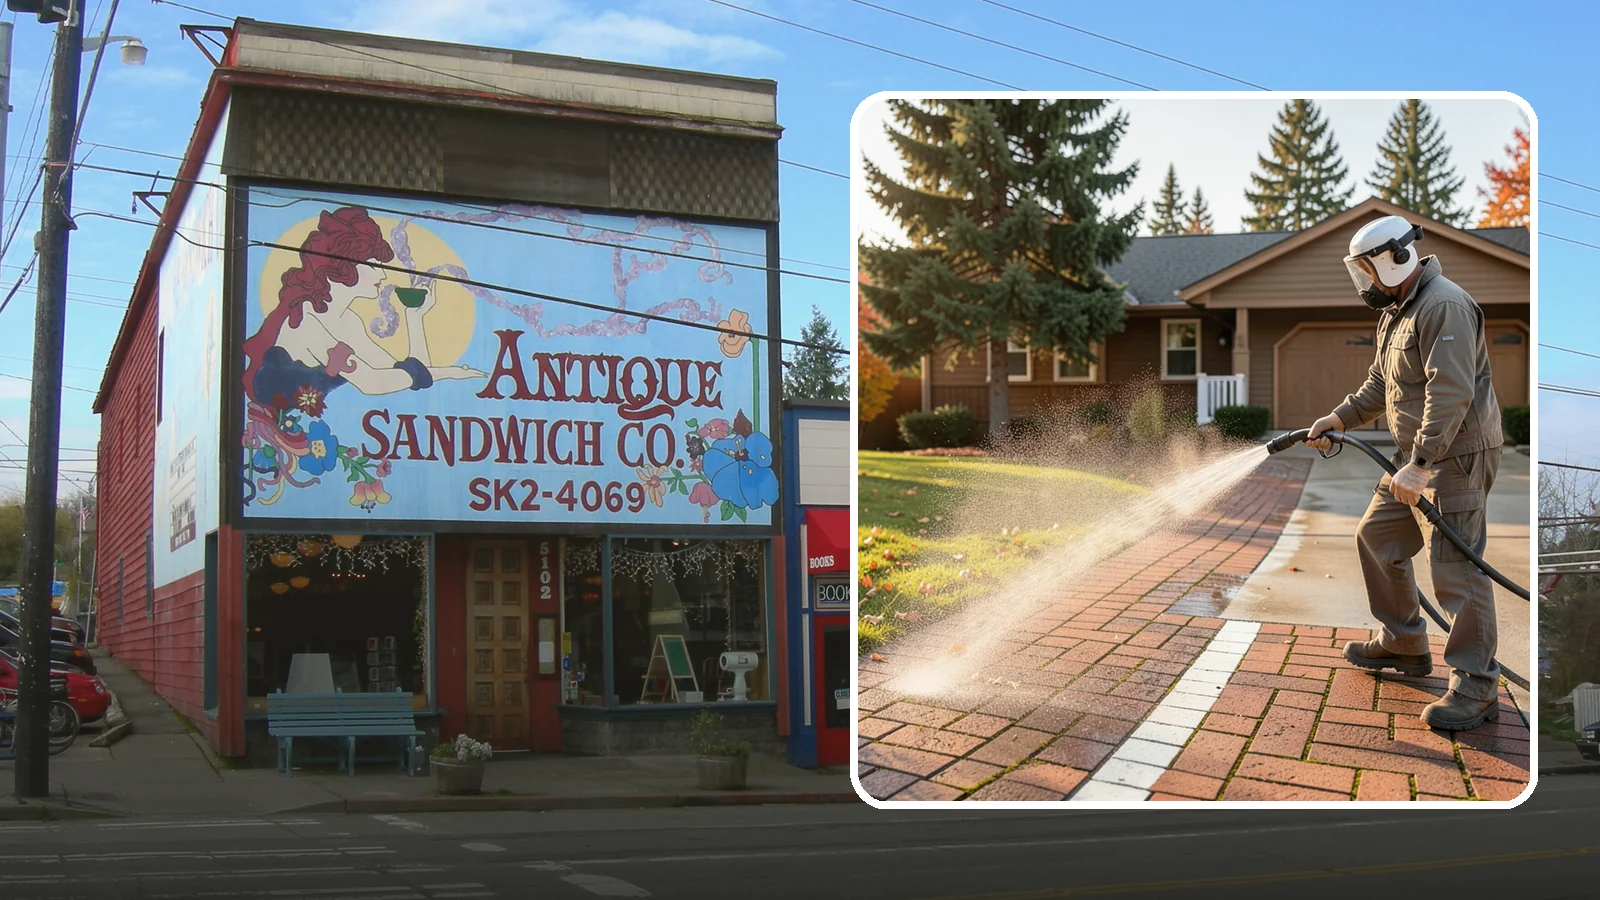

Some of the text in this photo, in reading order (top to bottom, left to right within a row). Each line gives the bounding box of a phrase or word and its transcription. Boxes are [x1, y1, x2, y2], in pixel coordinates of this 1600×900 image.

[476, 329, 724, 421] ANTIQUE
[361, 408, 685, 468] SANDWICH CO.
[468, 477, 646, 513] SK2-4069
[540, 541, 551, 600] 5102
[809, 555, 835, 569] BOOKS
